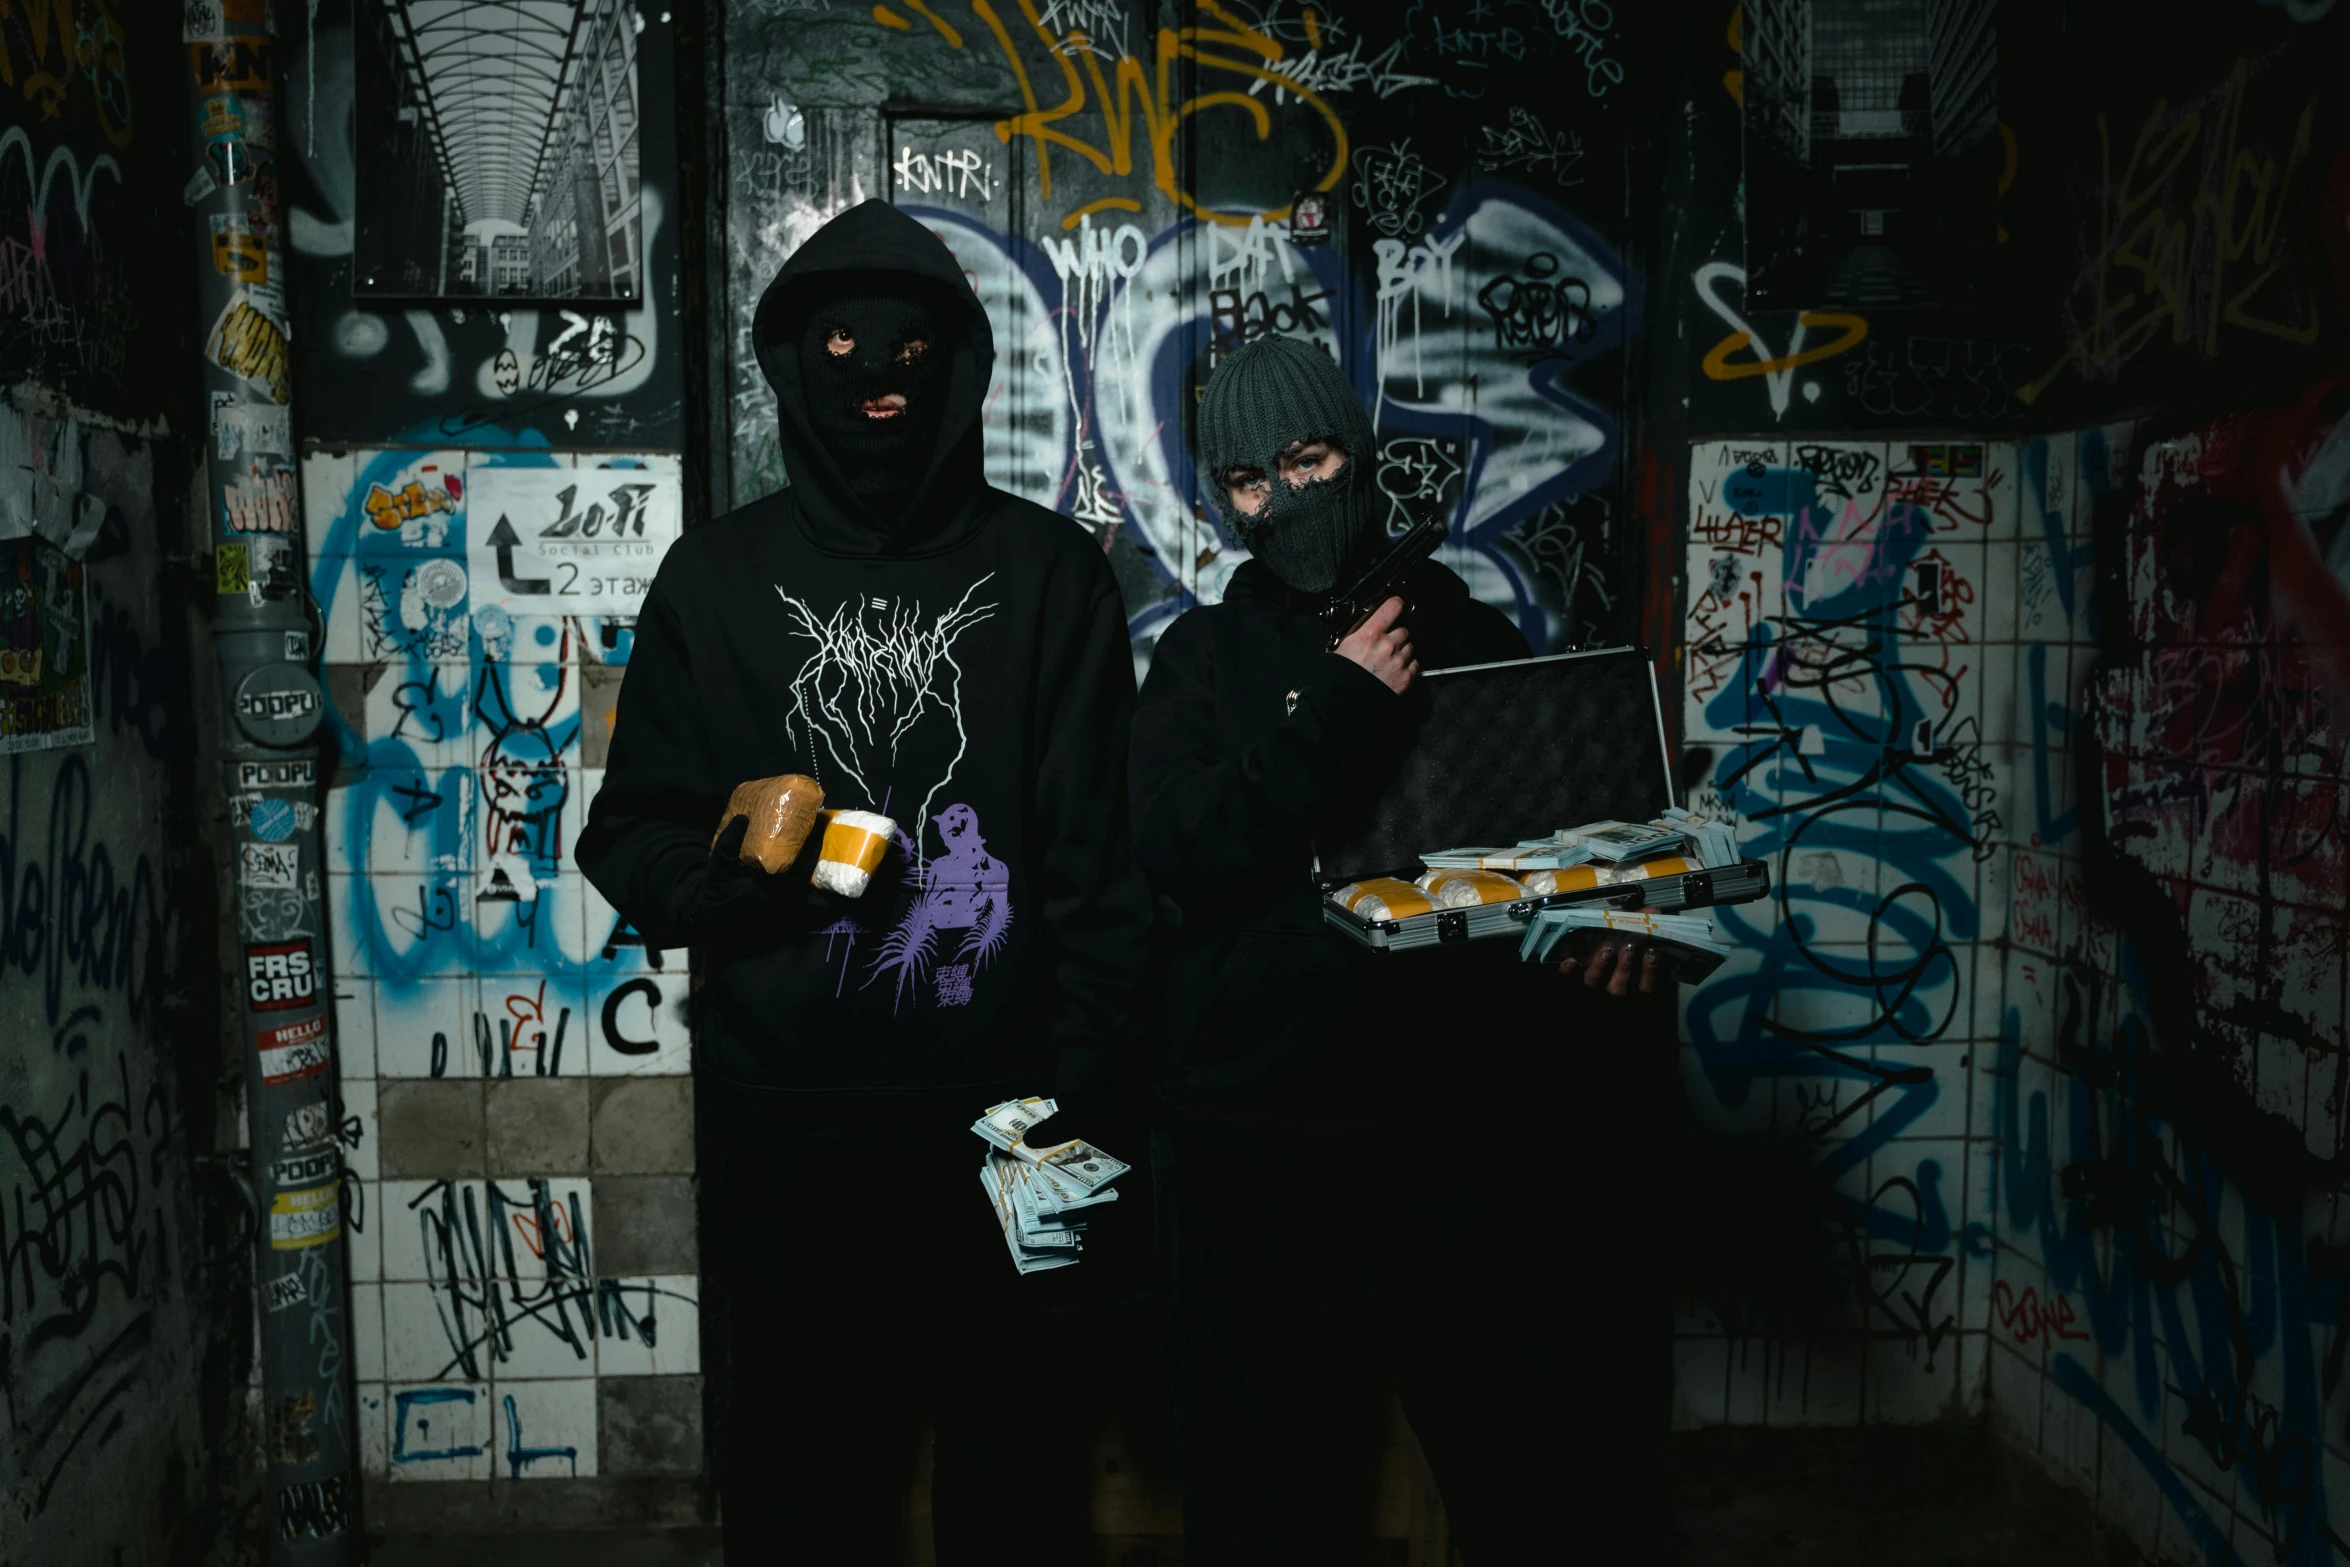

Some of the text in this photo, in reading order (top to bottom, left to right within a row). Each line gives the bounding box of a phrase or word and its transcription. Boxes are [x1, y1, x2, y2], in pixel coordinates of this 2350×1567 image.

[1042, 213, 1147, 280] WHO
[538, 544, 655, 557] Social Club
[556, 562, 653, 597] 2 этаж
[248, 950, 311, 979] FRS
[250, 974, 314, 1003] CRU
[275, 1019, 322, 1042] HELLO
